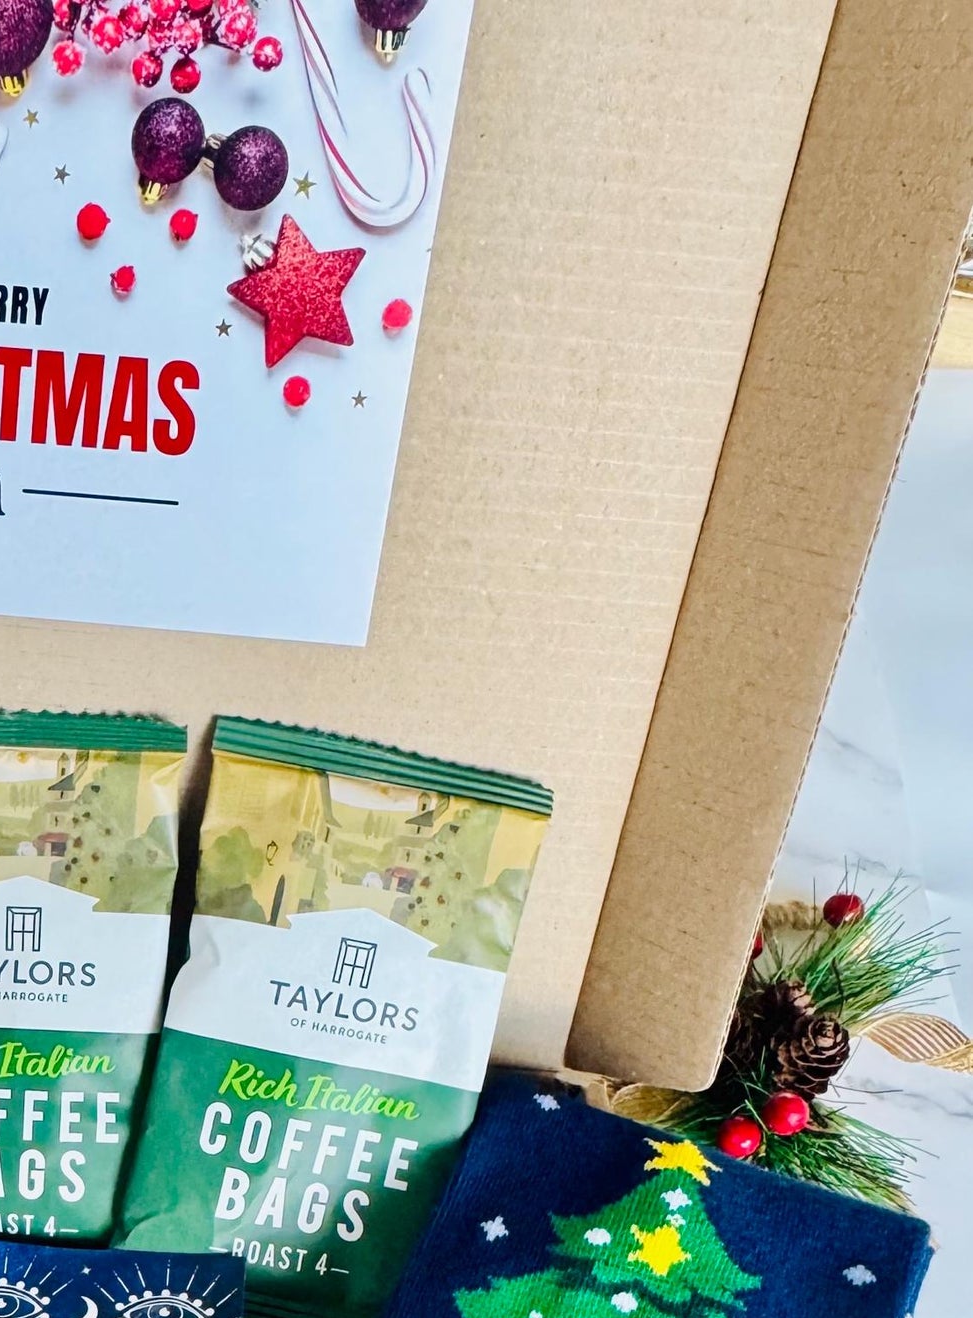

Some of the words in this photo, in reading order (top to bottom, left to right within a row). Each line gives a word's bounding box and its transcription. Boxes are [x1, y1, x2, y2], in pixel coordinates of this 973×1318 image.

[269, 979, 420, 1033] TAYLORS
[290, 1017, 308, 1029] OF
[311, 1021, 388, 1045] HARROGATE
[218, 1058, 297, 1109] Rich
[297, 1073, 421, 1121] Italian
[198, 1102, 420, 1192] COFFEE
[43, 1215, 58, 1238] 4
[214, 1166, 371, 1243] BAGS
[231, 1236, 308, 1273] ROAST
[315, 1252, 329, 1274] 4
